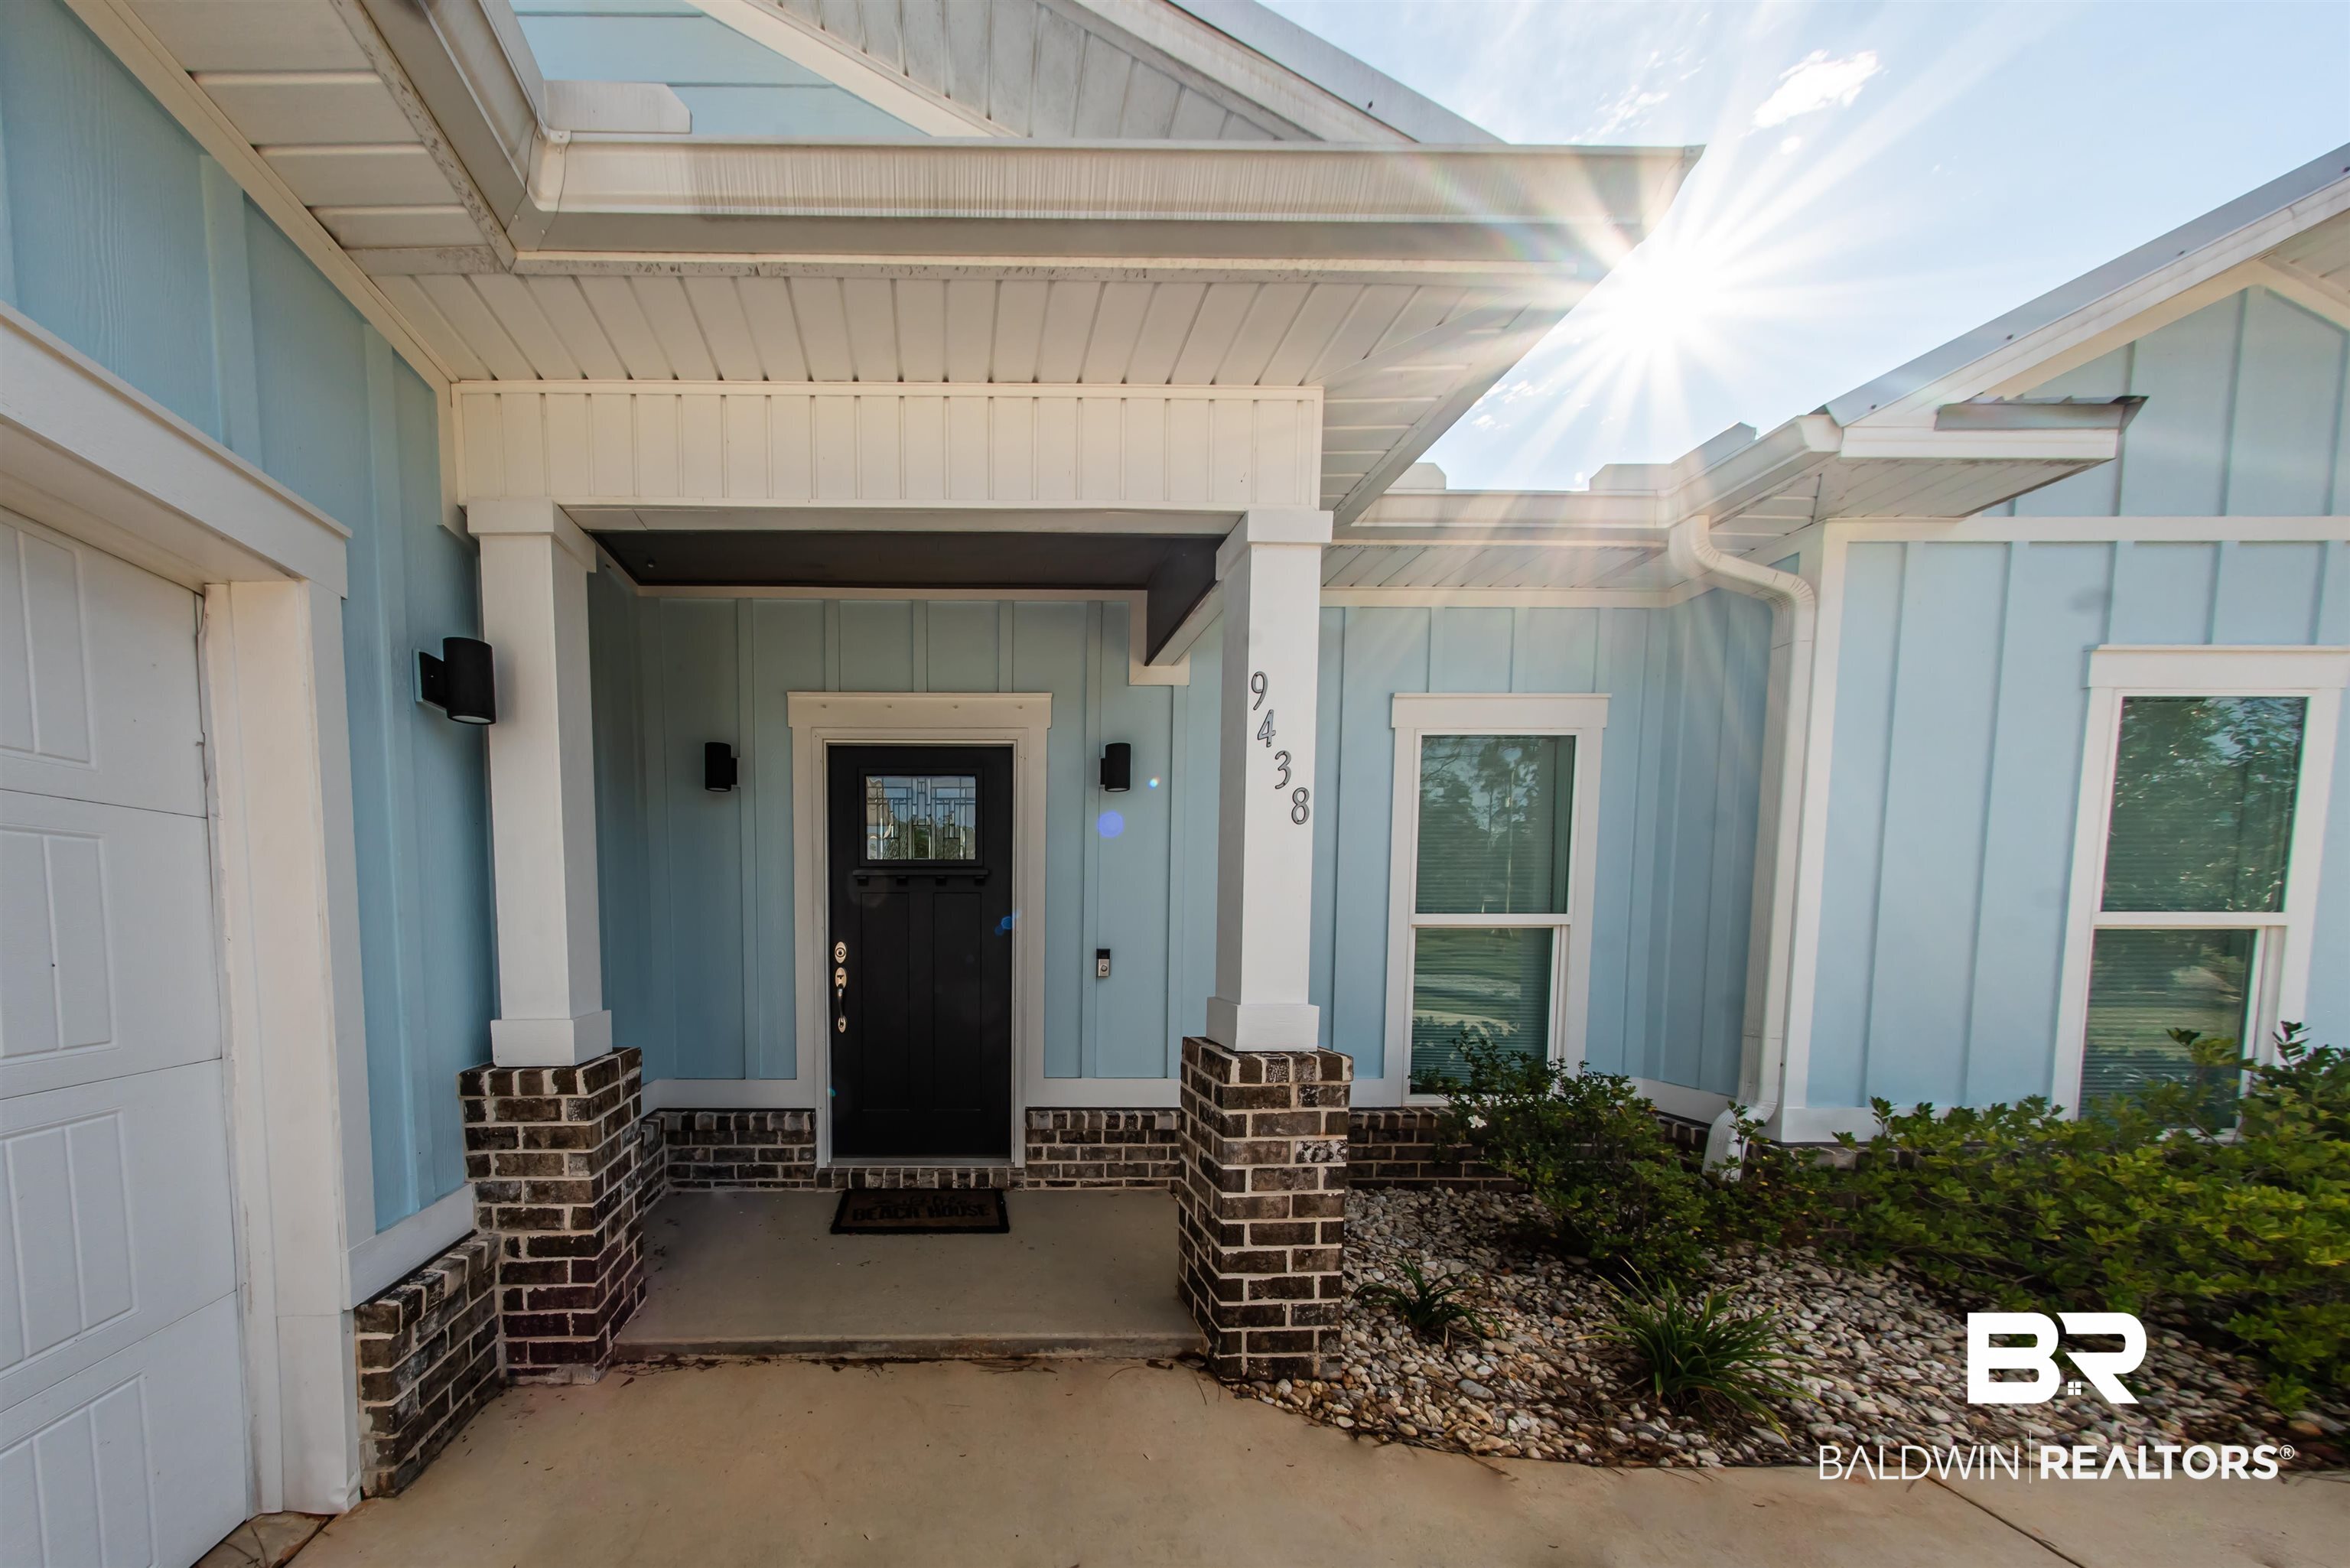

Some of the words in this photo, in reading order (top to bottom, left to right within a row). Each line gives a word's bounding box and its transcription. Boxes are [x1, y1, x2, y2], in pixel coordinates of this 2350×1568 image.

[1251, 671, 1310, 825] 9438
[852, 1204, 920, 1221] BEACH
[927, 1203, 991, 1218] HOUSE
